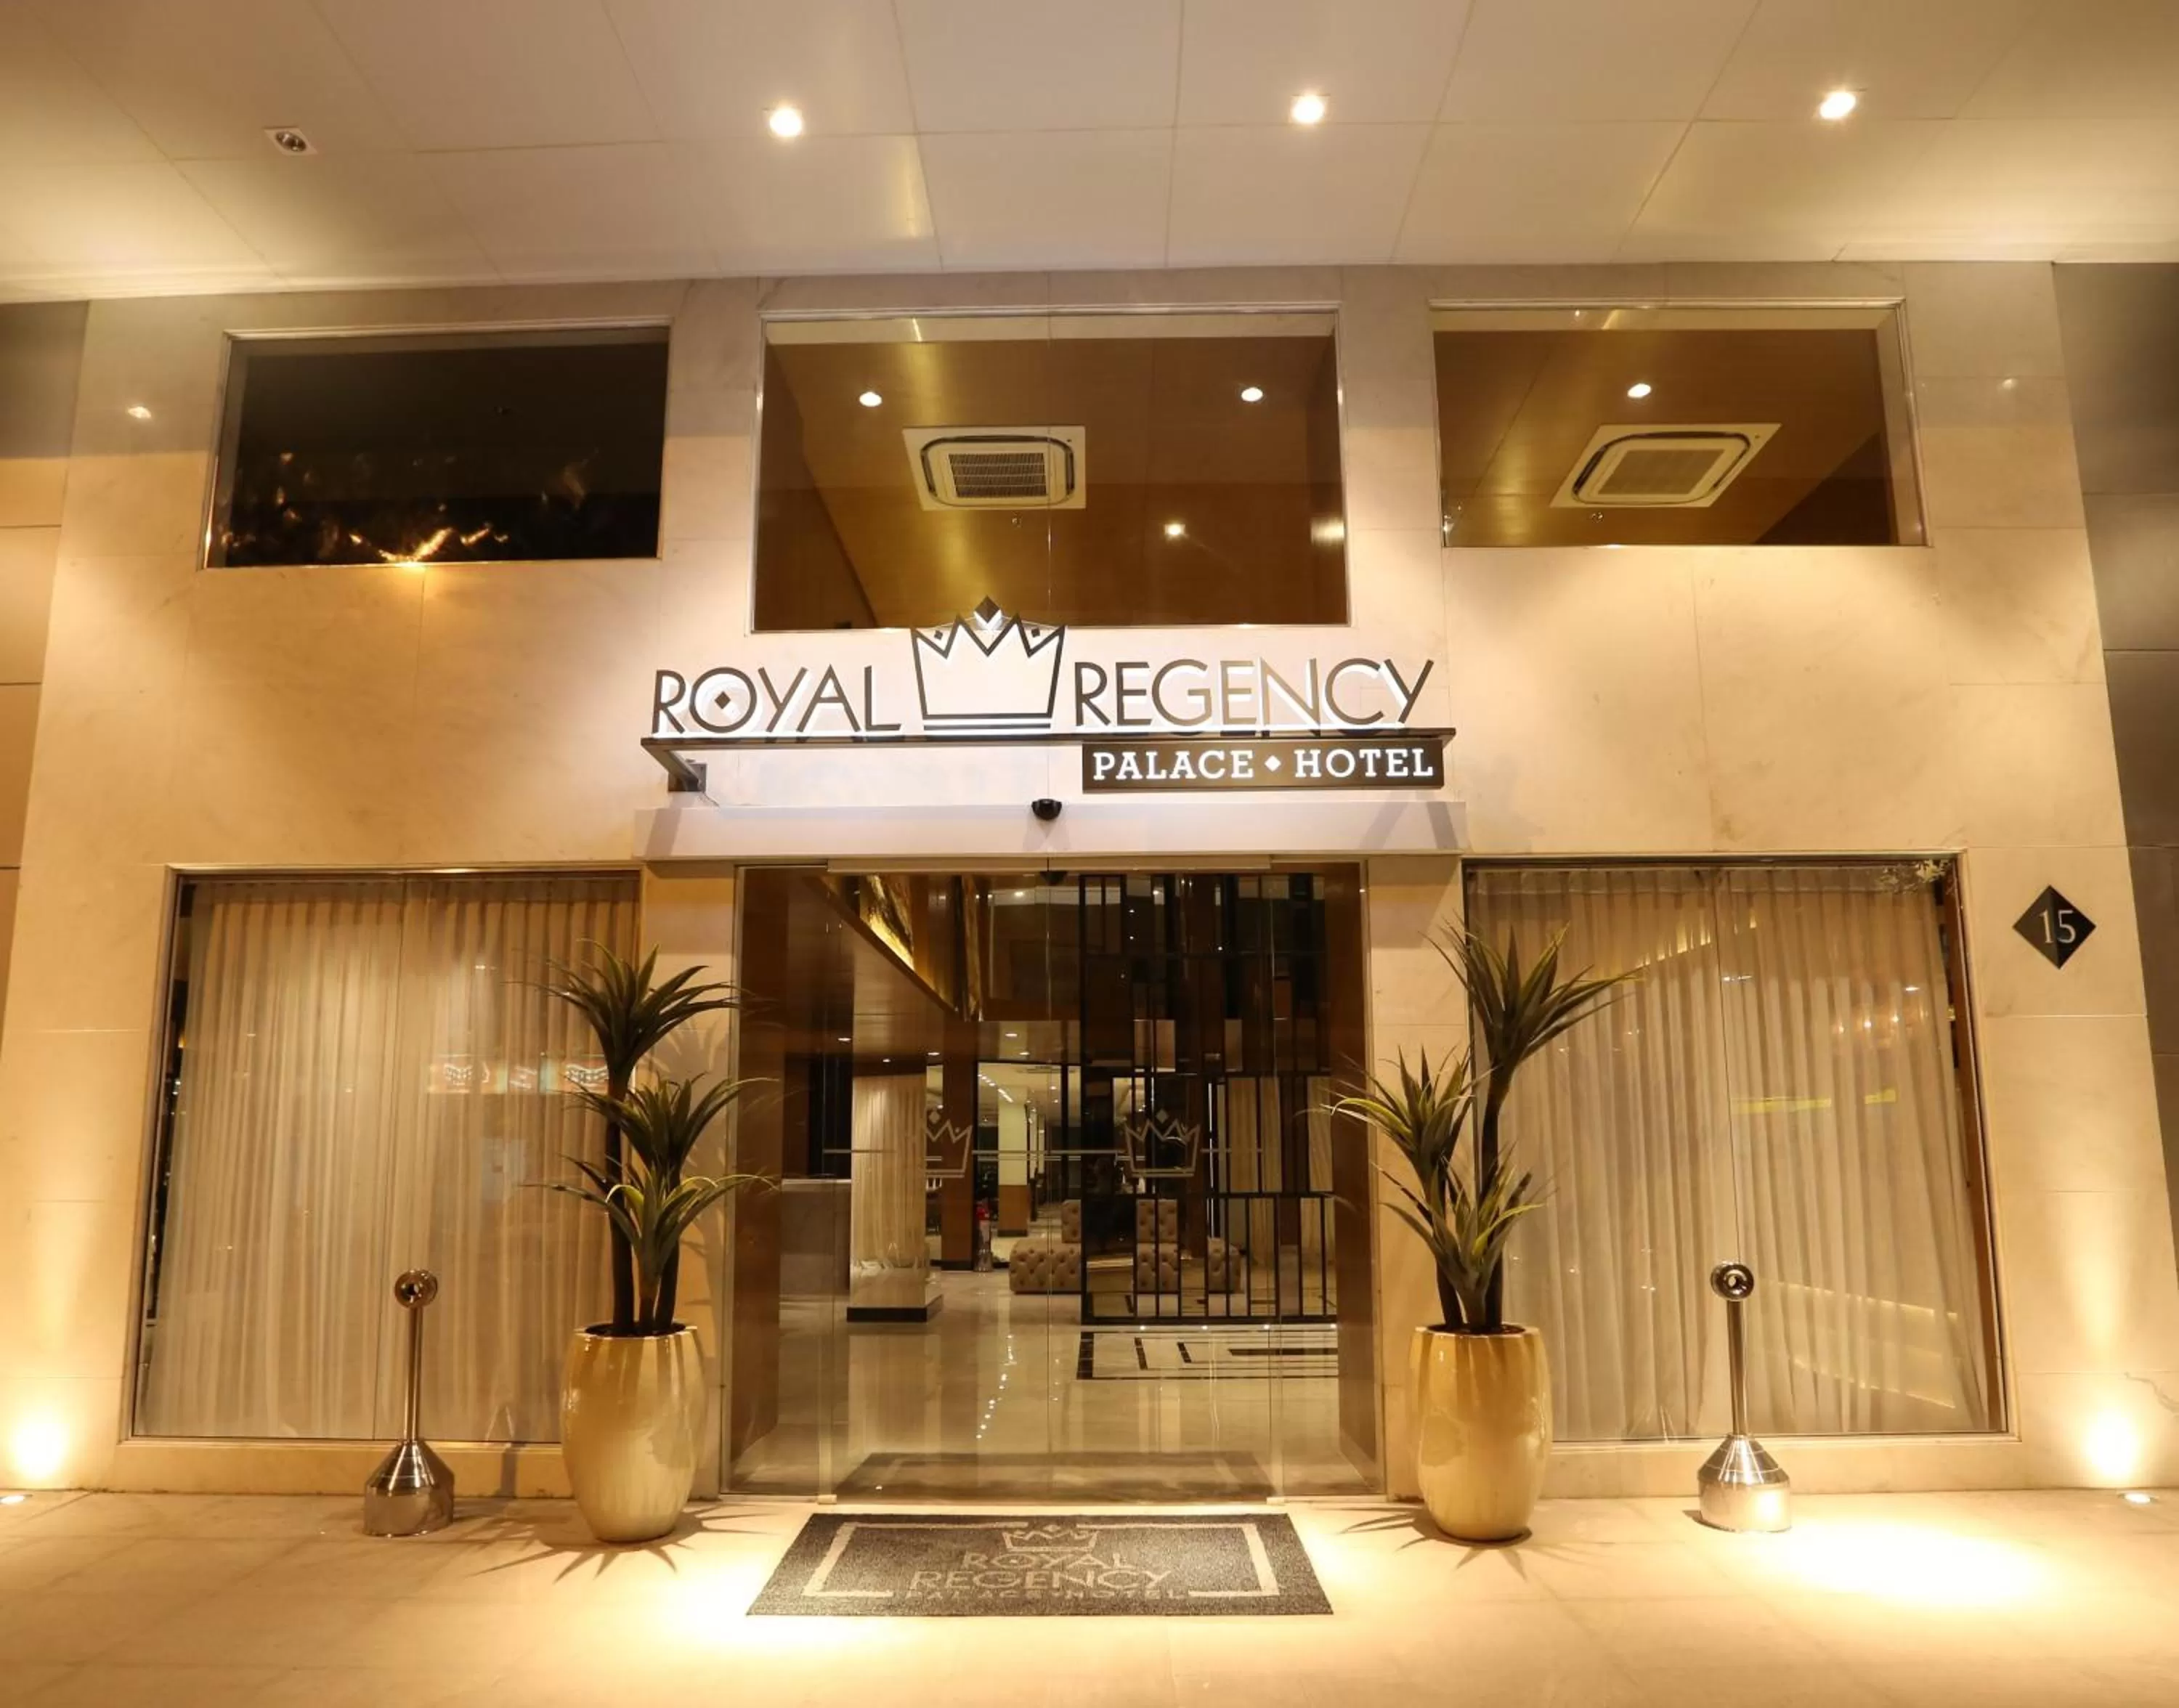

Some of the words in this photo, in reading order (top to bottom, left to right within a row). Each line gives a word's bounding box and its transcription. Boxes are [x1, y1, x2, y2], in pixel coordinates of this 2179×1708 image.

[652, 664, 902, 733] ROYAL
[1074, 657, 1435, 726] REGENCY
[1093, 750, 1254, 781] PALACE
[1294, 748, 1434, 778] HOTEL
[2039, 908, 2076, 943] 15
[961, 1553, 1137, 1569] ROYAL
[909, 1569, 1172, 1589] REGENCY
